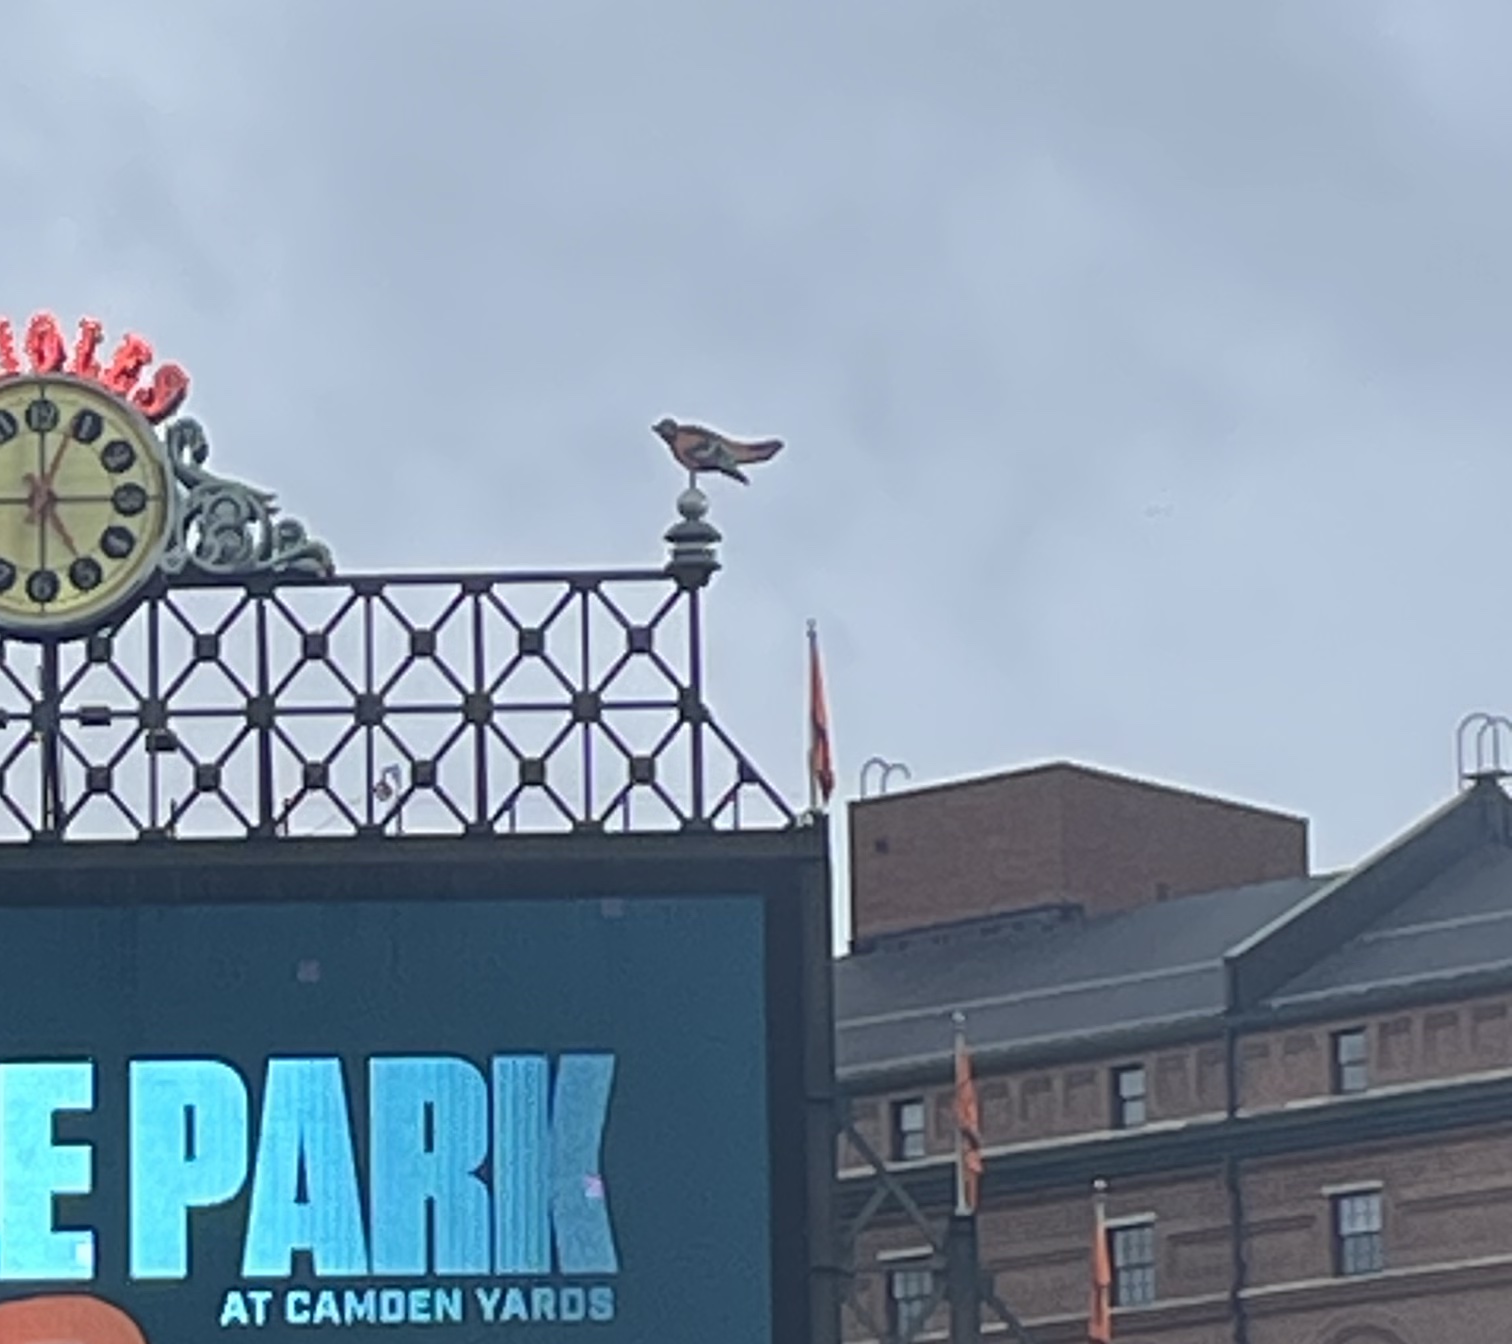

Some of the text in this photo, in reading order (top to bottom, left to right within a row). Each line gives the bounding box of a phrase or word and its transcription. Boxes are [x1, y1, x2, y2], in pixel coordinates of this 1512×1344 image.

[129, 1054, 619, 1279] PARK
[220, 1286, 615, 1327] AT CAMDEN YARDS
